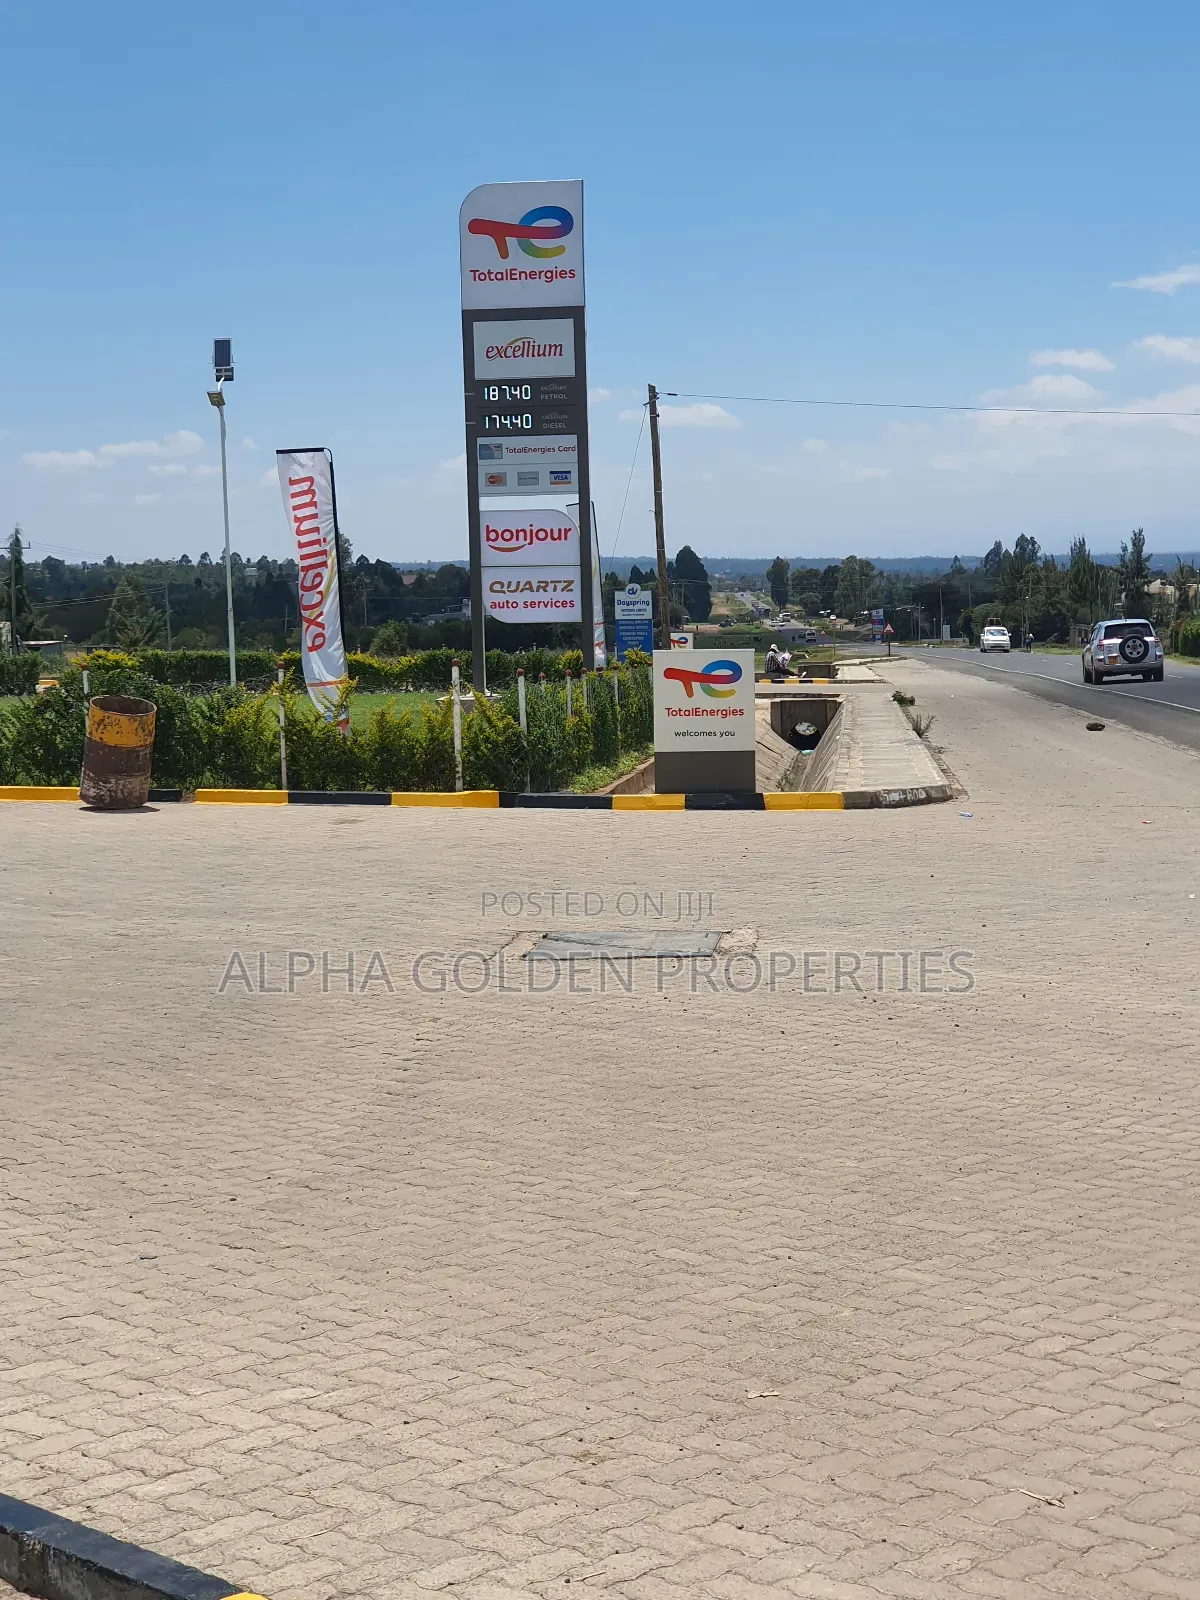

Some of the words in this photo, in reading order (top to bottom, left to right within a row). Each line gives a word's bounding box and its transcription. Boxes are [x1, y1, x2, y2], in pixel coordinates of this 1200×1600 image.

[469, 266, 576, 283] TotalEnergies
[485, 340, 563, 361] excellium
[485, 385, 531, 400] 187.40
[485, 414, 532, 429] 174.40
[505, 445, 555, 455] TotalEnergies
[557, 444, 576, 453] Card
[485, 523, 572, 546] bonjour
[489, 579, 574, 595] QUARTZ
[490, 600, 519, 609] auto
[522, 598, 575, 609] services
[617, 599, 650, 607] Dayspring
[665, 707, 744, 719] TotalEnergies
[674, 729, 717, 737] welcomes
[719, 730, 735, 739] you
